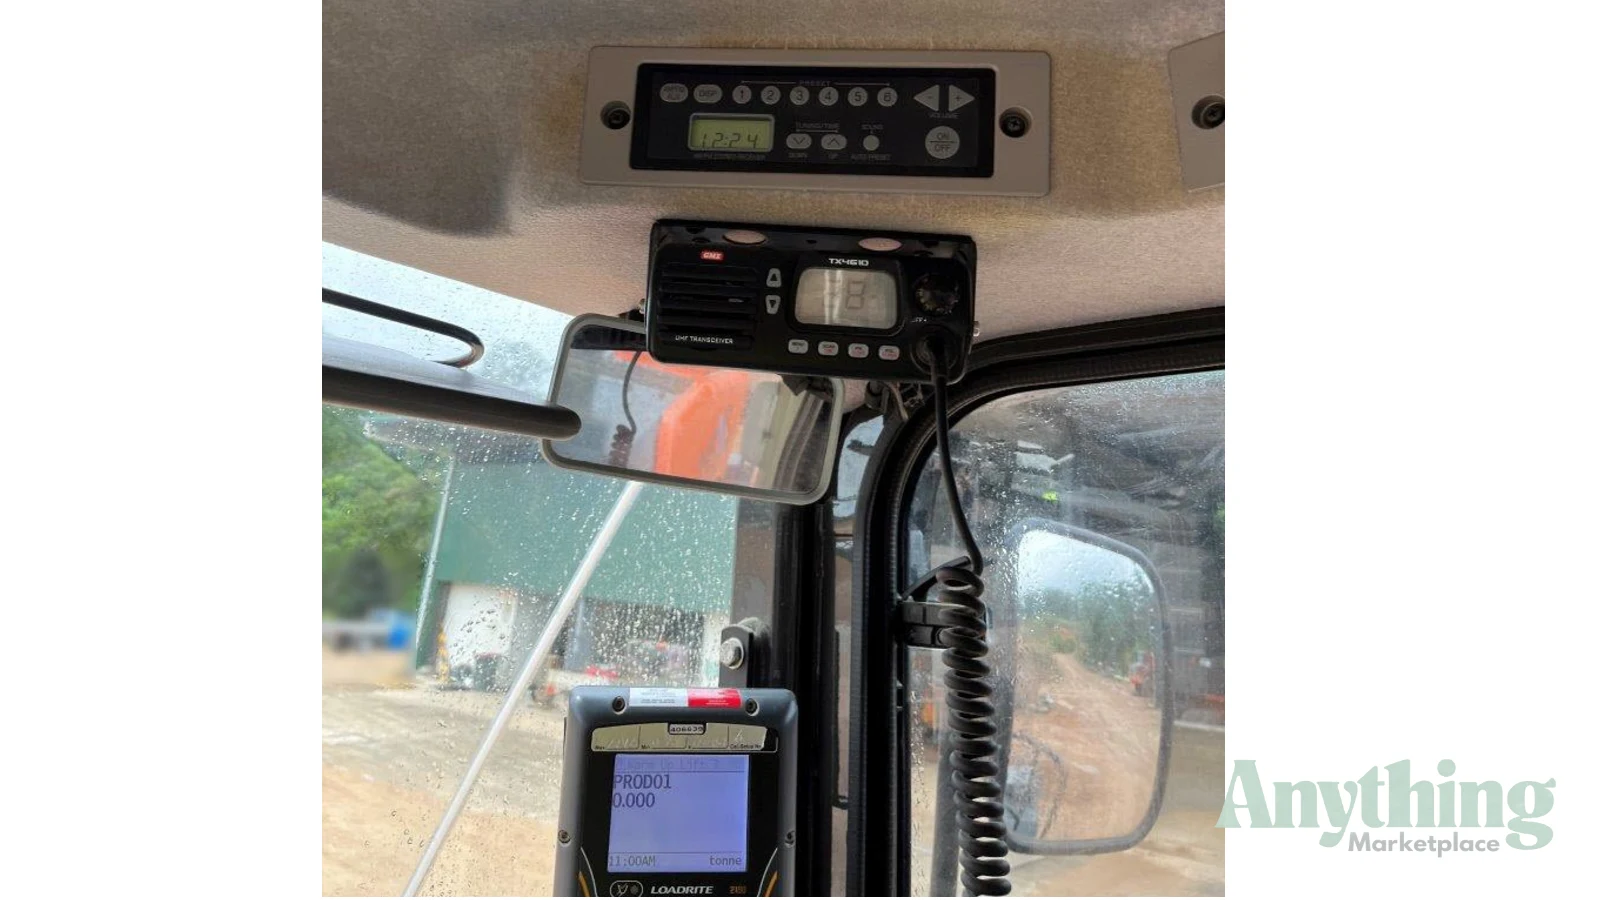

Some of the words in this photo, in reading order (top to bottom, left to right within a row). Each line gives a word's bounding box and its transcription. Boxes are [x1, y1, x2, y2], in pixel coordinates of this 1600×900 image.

[702, 132, 758, 149] 12:24
[934, 143, 950, 152] OFF
[828, 257, 869, 267] TX4610
[689, 335, 734, 344] TRANSCEIVER
[612, 774, 671, 790] PROD01
[612, 792, 656, 808] 0.000
[608, 855, 656, 867] 11:00AM
[709, 855, 742, 867] tonne
[650, 885, 714, 895] LOADRITE
